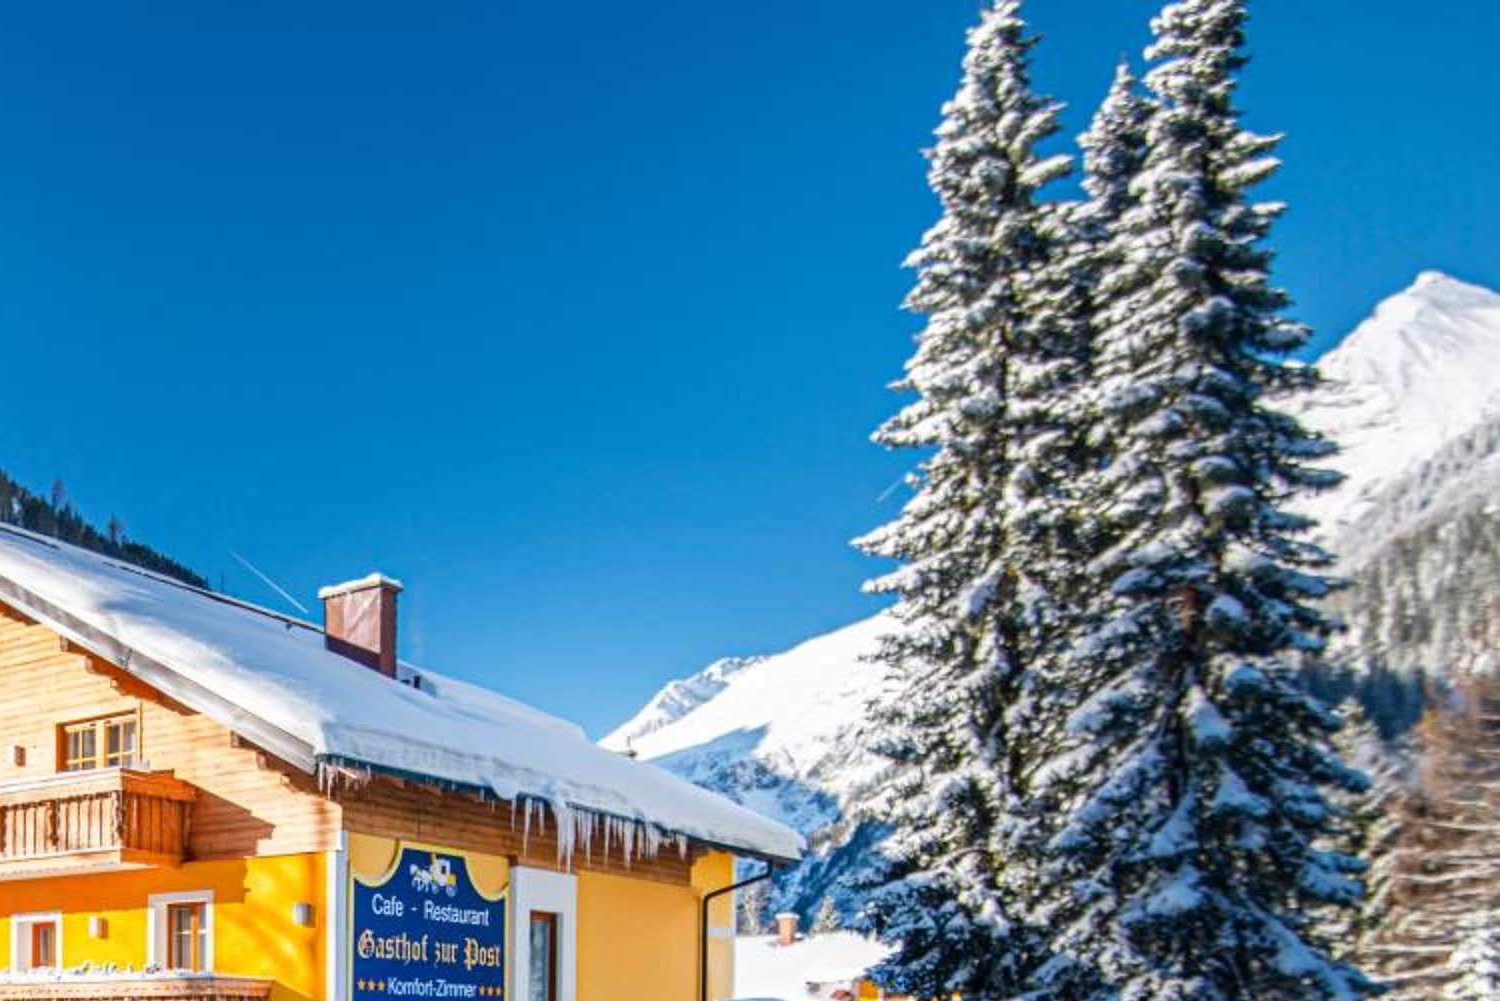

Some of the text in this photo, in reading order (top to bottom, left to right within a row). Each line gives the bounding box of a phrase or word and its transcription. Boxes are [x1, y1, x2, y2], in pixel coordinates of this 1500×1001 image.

[371, 893, 404, 917] Cafe
[423, 899, 490, 926] Restaurant
[357, 928, 501, 971] Gasthof zur Post
[387, 977, 478, 998] Komfort-Zimmer
